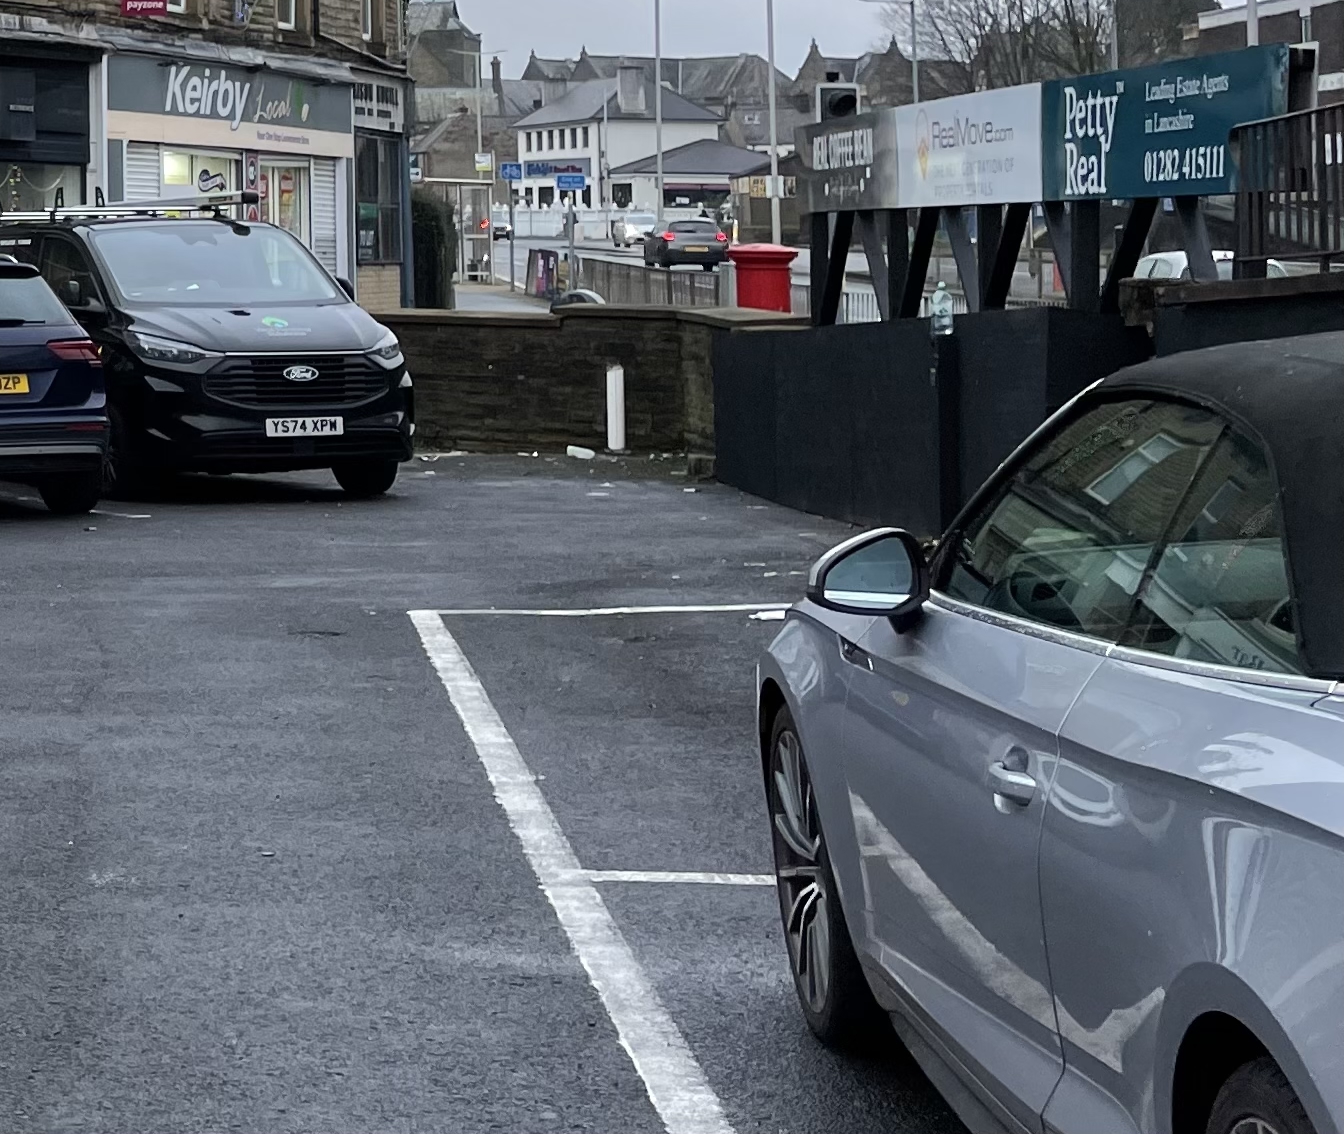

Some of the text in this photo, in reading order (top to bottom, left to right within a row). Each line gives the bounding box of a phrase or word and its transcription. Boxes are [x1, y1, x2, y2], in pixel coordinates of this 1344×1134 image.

[126, 1, 164, 11] payzone
[165, 65, 250, 130] Keirby
[253, 77, 292, 123] Local
[1145, 73, 1229, 104] Leading Estate Agents
[1064, 86, 1118, 153] Petty
[1154, 109, 1194, 132] Lancashire
[813, 129, 873, 170] REAL COFFEE BEAN
[1064, 136, 1107, 196] Real
[1144, 145, 1224, 182] 01282 415111
[290, 368, 312, 379] Ford
[272, 419, 337, 433] YS74 XPW
